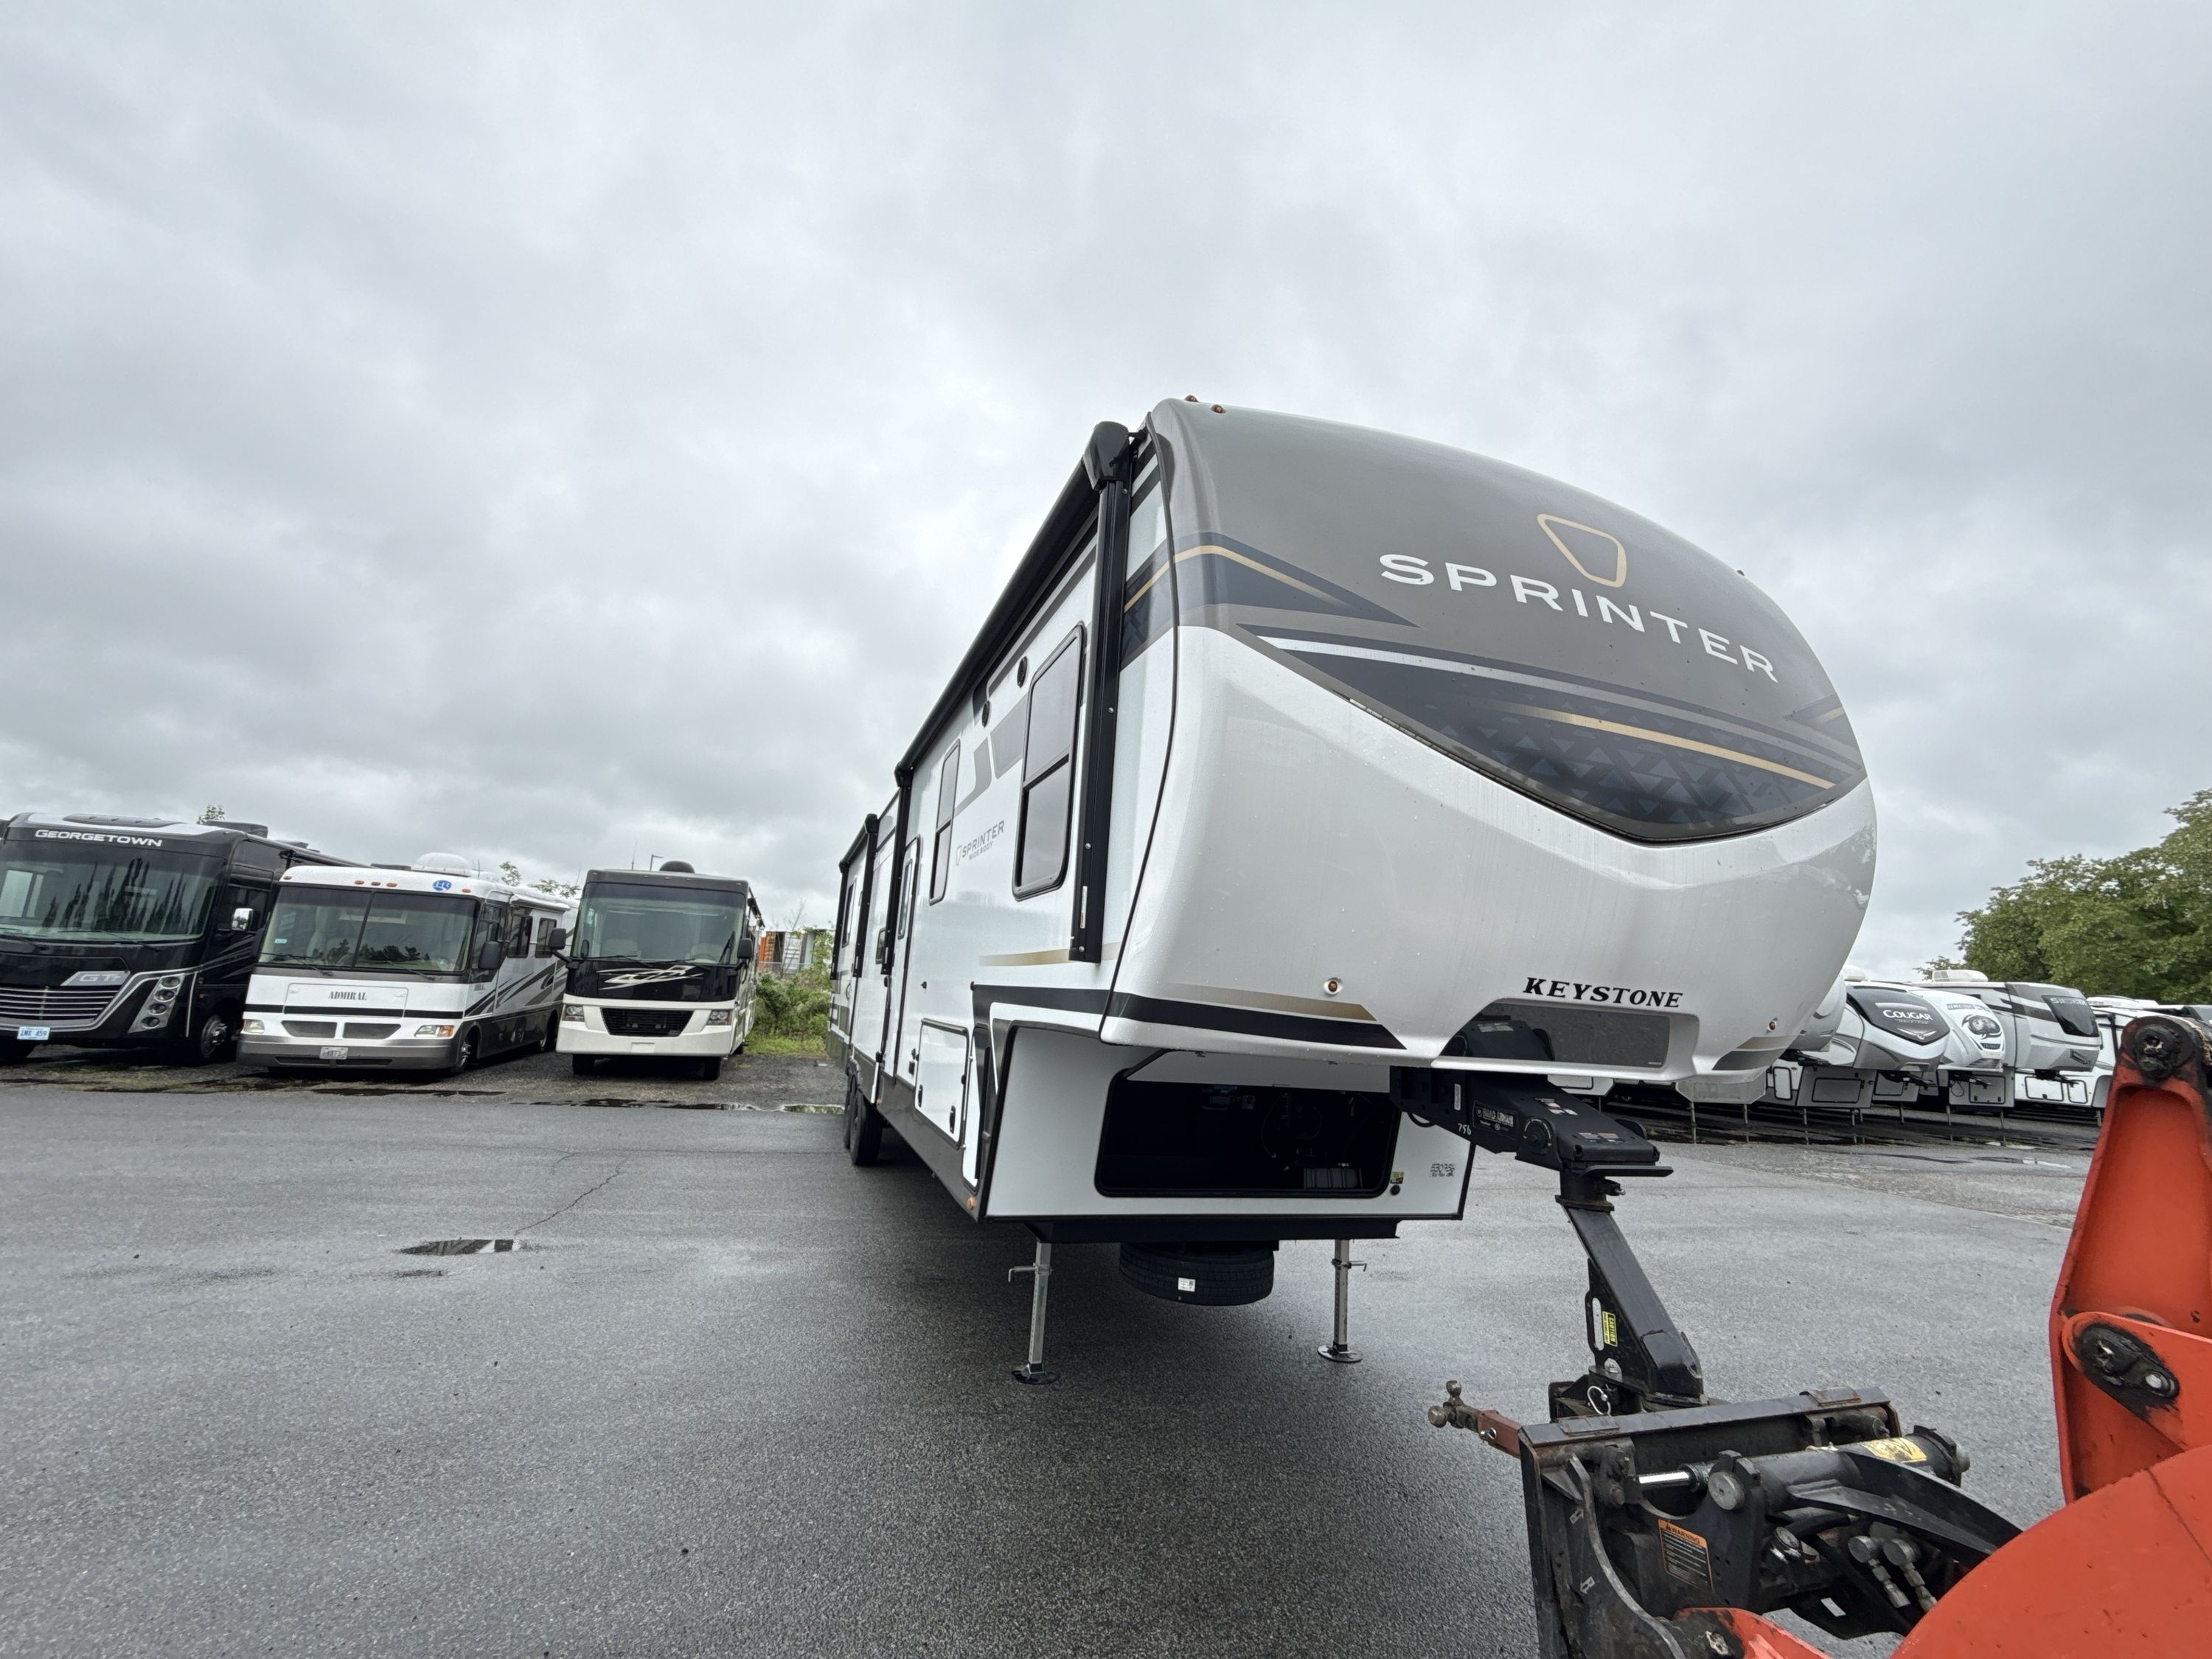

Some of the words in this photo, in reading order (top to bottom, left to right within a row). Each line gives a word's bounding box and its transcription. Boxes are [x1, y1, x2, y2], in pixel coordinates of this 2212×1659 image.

[1380, 553, 1778, 683] SPRINTER
[35, 829, 163, 847] GEORGETOWN
[961, 819, 1004, 858] SPRINTER
[328, 991, 367, 1001] ADMIRAL
[1523, 977, 1683, 1008] KEYSTONE
[1882, 1009, 1933, 1020] COUGAR
[1458, 1123, 1472, 1135] 756
[1671, 1526, 1700, 1545] WARNING
